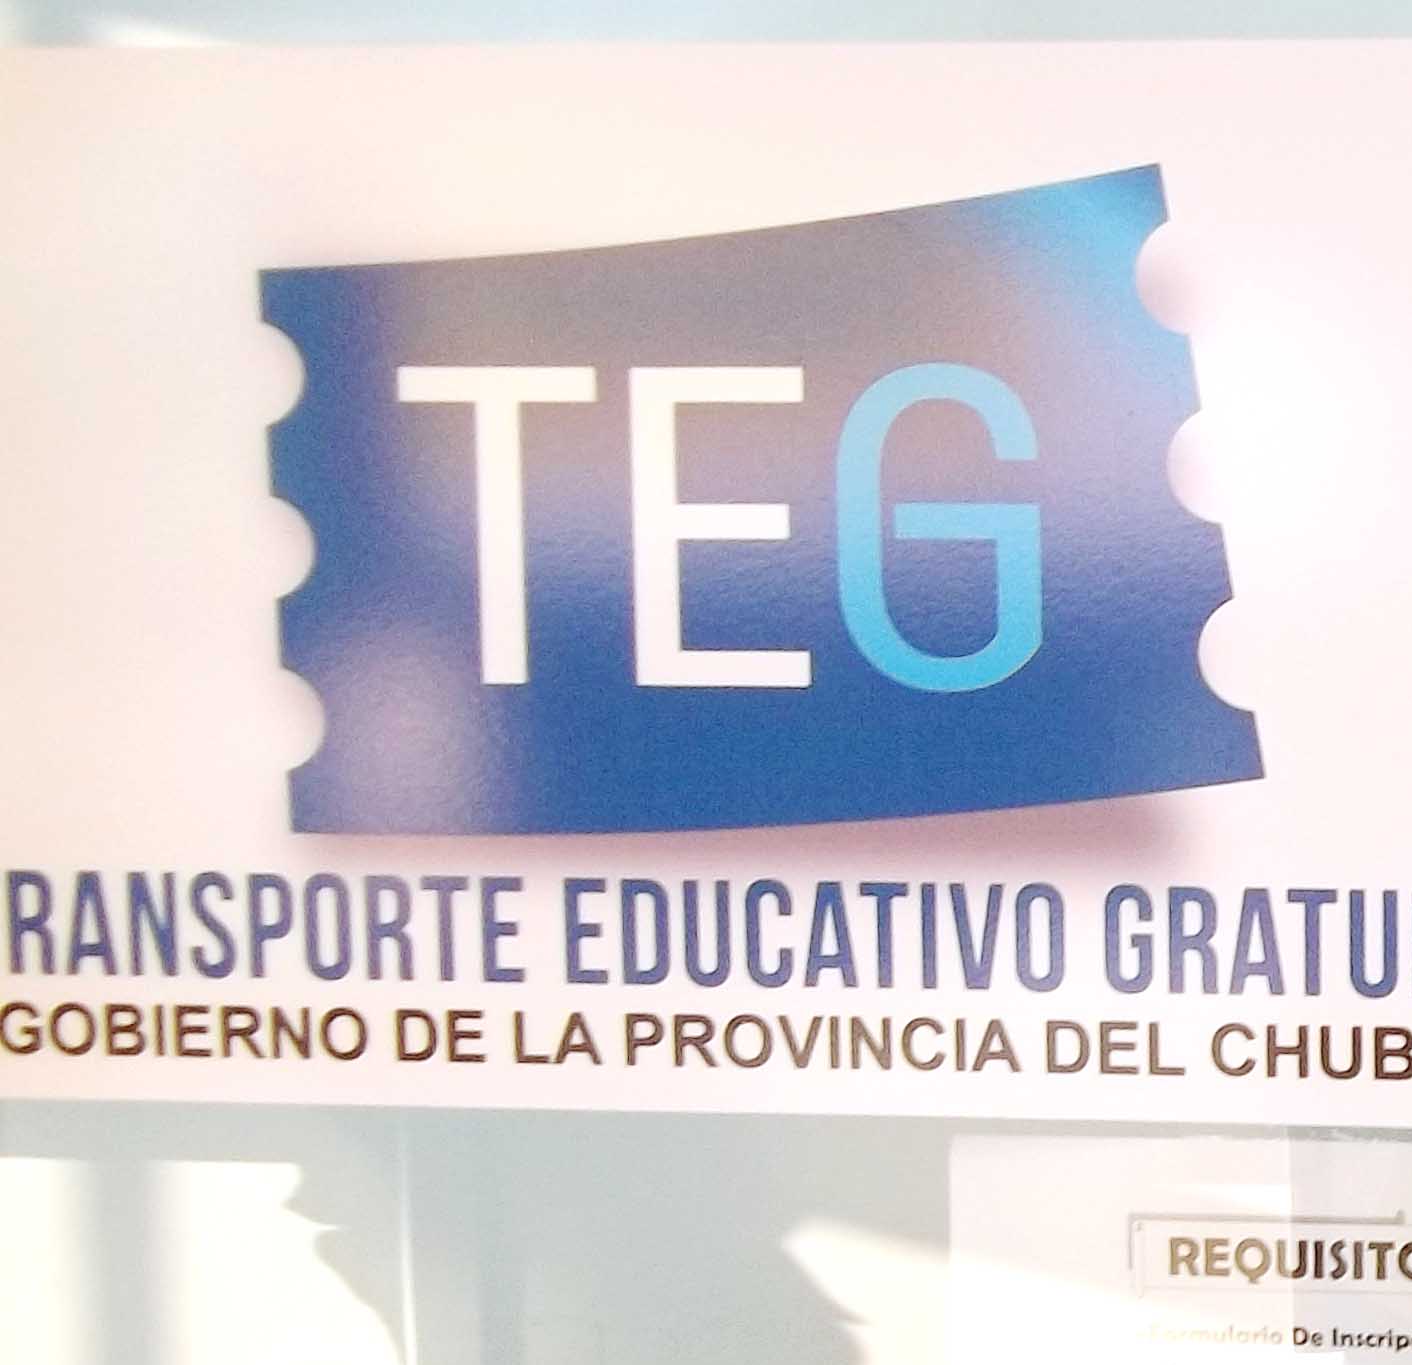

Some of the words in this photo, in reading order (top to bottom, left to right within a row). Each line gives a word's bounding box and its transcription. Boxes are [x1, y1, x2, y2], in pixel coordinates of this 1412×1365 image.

[396, 362, 1044, 692] TEG
[7, 869, 525, 984] RANSPORTE
[563, 877, 1067, 992] EDUCATIVO
[0, 1002, 368, 1061] GOBIERNO
[398, 1008, 487, 1064] DE
[513, 1010, 603, 1066] LA
[625, 1012, 1023, 1074] PROVINCIA
[1045, 1019, 1187, 1076] DEL
[1292, 1326, 1324, 1347] De
